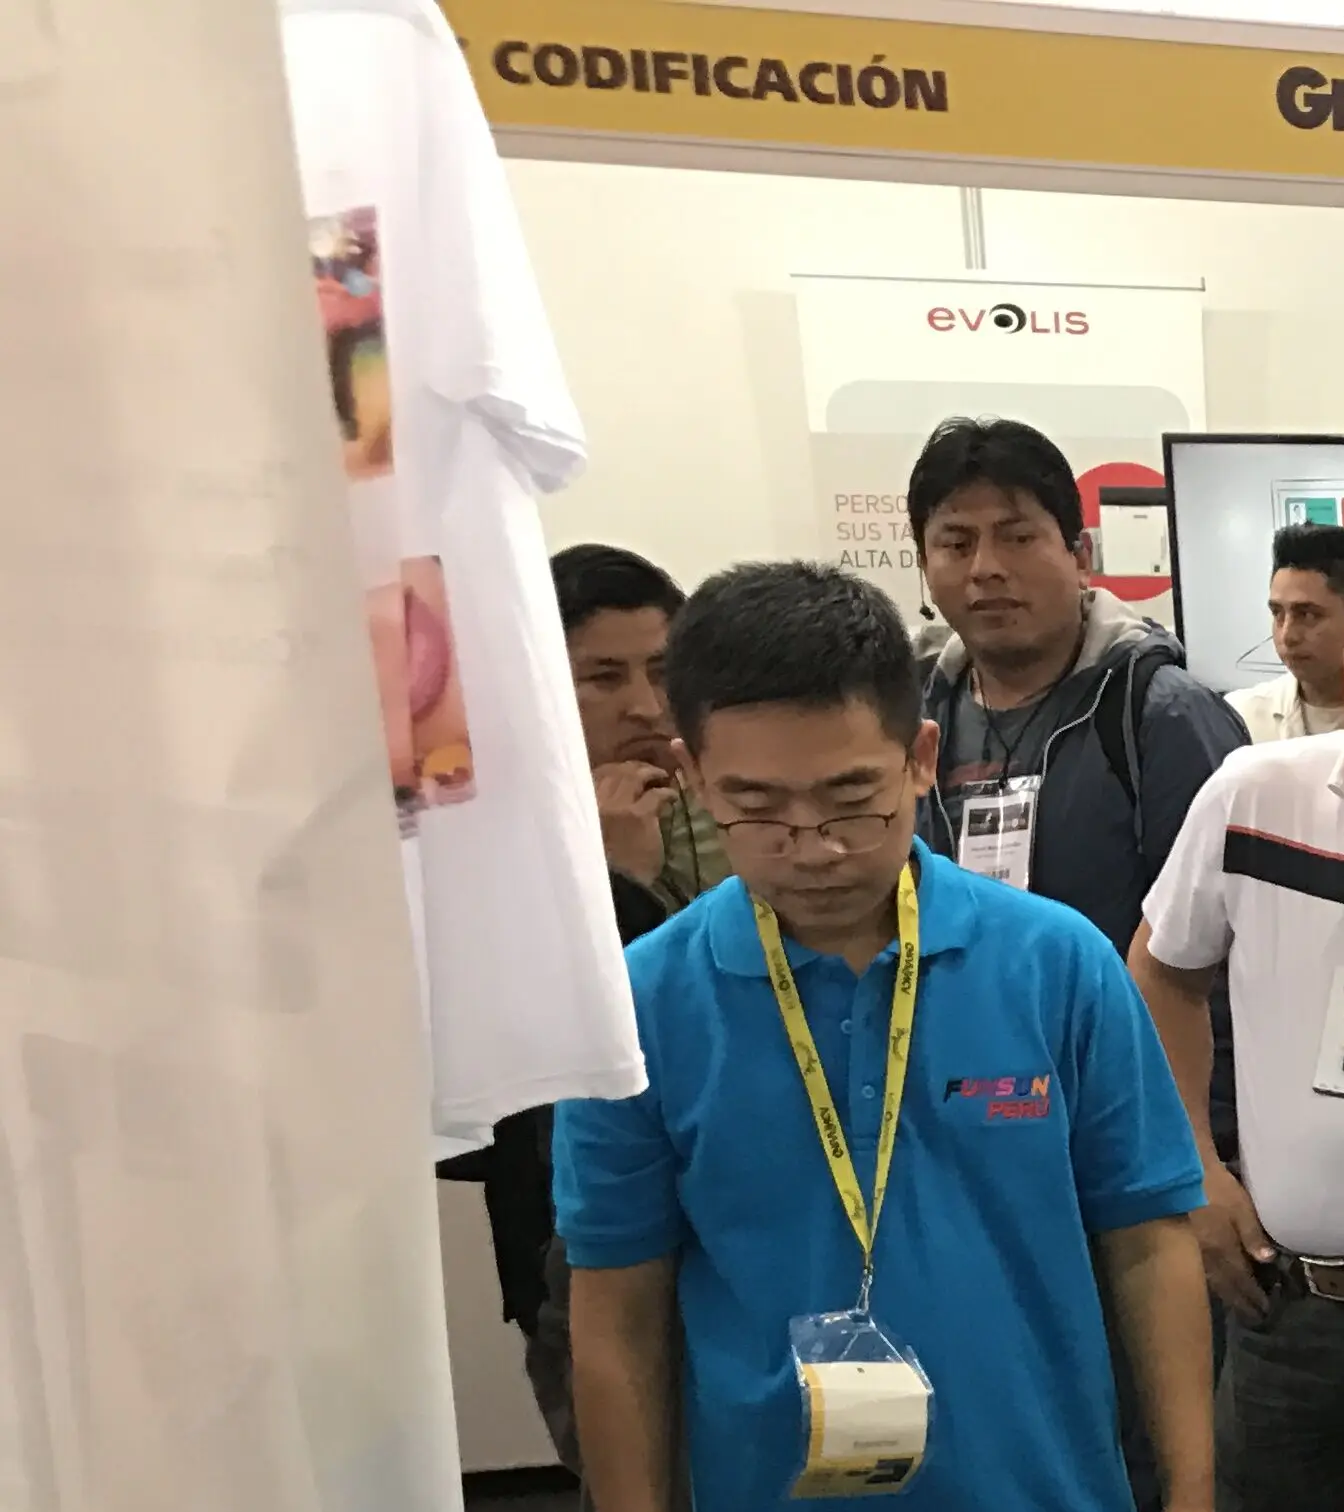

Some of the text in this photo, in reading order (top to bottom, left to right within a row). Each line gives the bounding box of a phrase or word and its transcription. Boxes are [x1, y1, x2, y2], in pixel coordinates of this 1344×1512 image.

[493, 40, 950, 112] CODIFICACIÓN
[837, 522, 882, 541] SUS
[840, 550, 893, 568] ALTA
[943, 1074, 1050, 1103] FUNSUN
